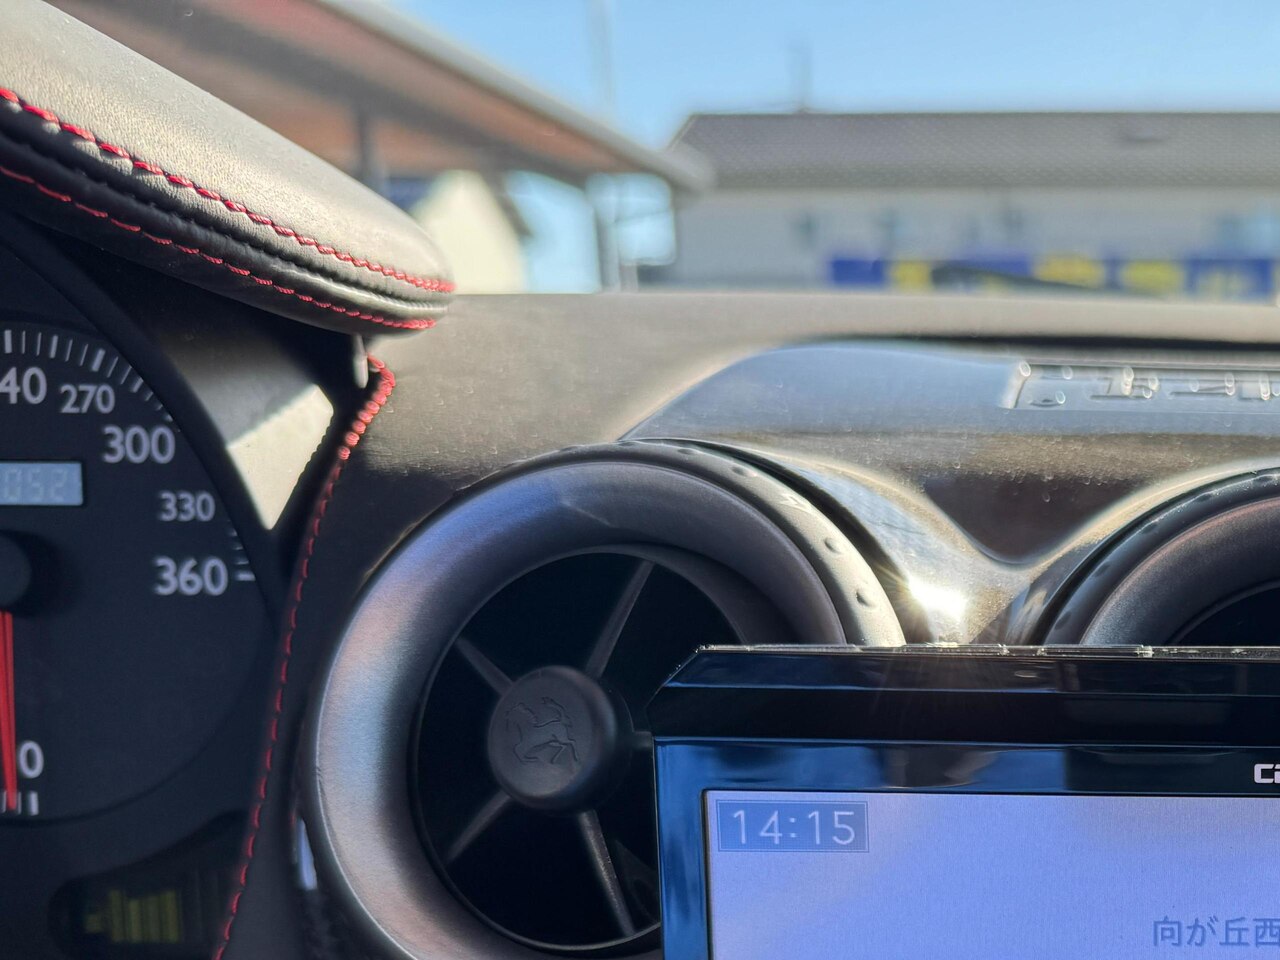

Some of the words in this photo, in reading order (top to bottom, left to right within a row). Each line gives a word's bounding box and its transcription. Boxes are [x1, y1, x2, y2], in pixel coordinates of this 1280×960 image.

[60, 384, 115, 413] 270
[103, 424, 176, 464] 300
[159, 490, 216, 522] 330
[155, 556, 228, 596] 360
[18, 740, 45, 779] 0
[733, 809, 856, 845] 14:15
